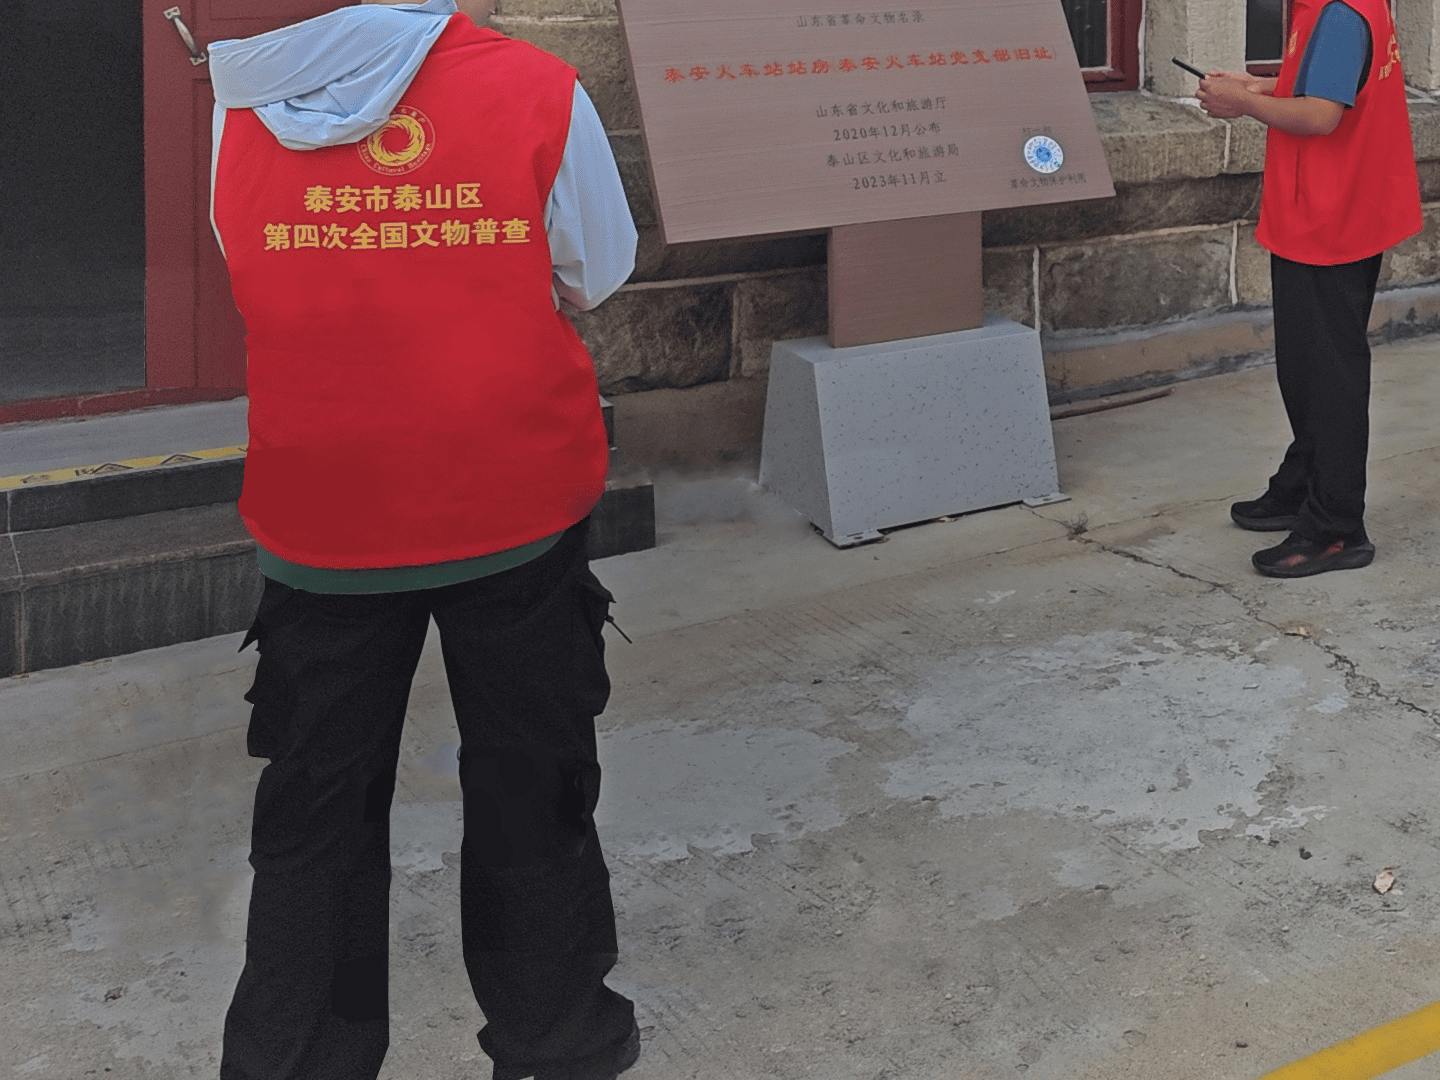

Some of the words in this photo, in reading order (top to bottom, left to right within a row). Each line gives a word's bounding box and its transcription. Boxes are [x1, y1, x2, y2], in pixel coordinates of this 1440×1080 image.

[796, 9, 924, 28] 山东省革命文物名录
[815, 96, 947, 118] 山东省文化和旅游厅
[833, 121, 941, 142] 2020年12月公布
[826, 143, 960, 167] 泰山区文化和旅游局
[853, 170, 947, 190] 2023年11月立
[303, 183, 484, 213] 泰安市泰山区
[263, 218, 531, 251] 第四次全国文物普查
